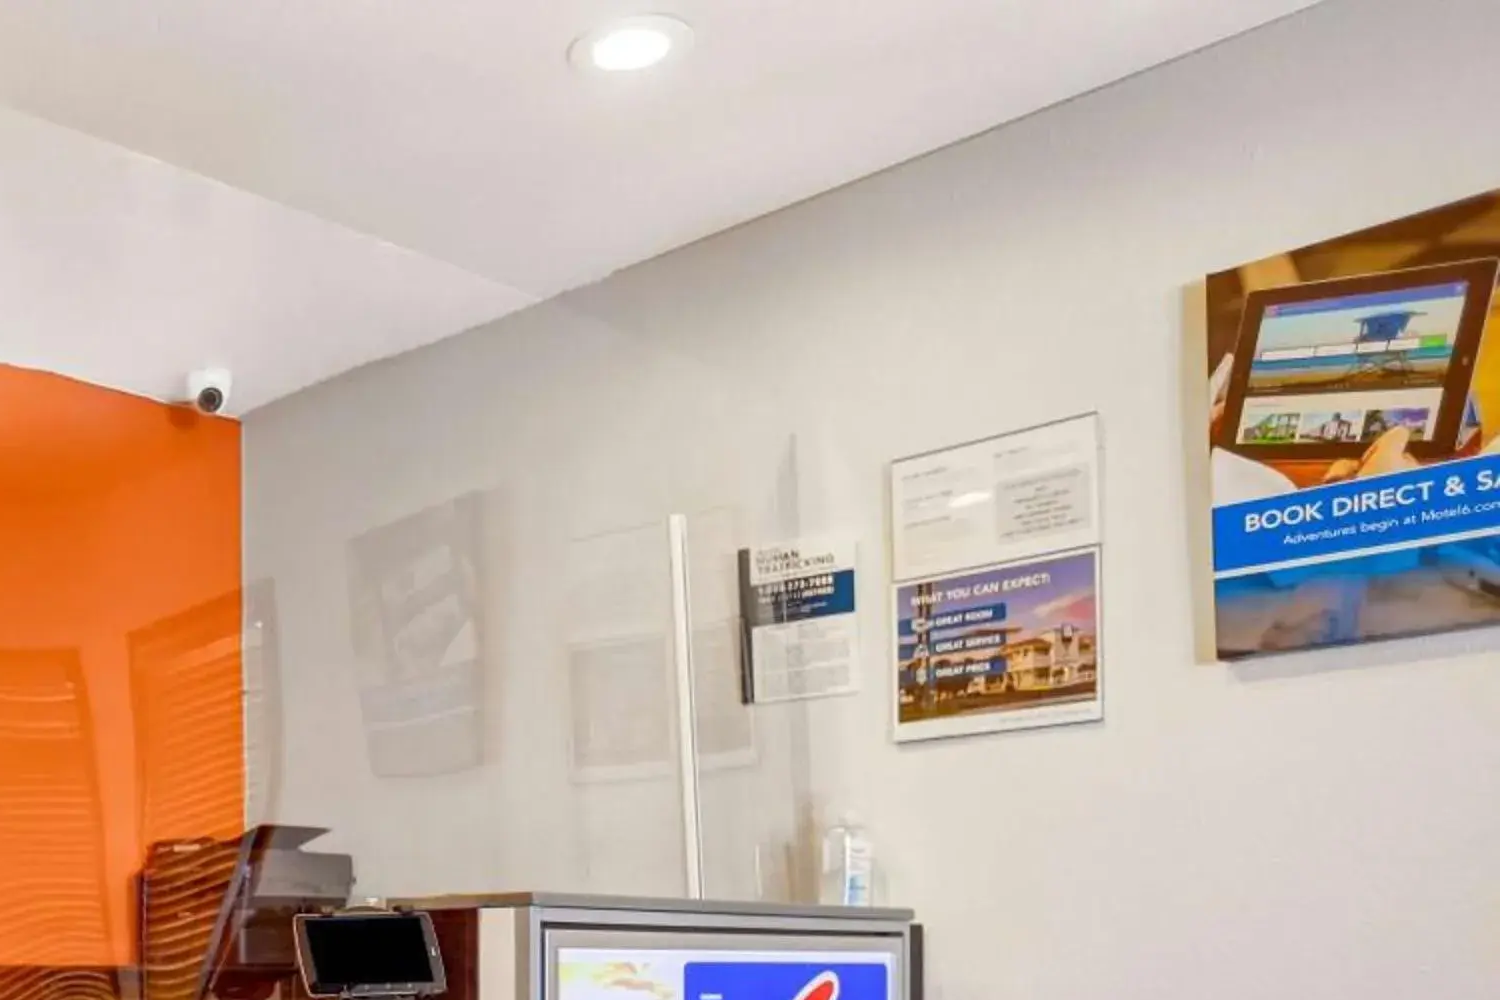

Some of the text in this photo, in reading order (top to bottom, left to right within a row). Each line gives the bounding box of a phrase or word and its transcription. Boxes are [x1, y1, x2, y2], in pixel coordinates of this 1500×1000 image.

[1244, 501, 1324, 533] BOOK
[1332, 480, 1435, 517] DIRECT
[1443, 475, 1467, 497] &
[1283, 525, 1357, 545] Adventures
[1360, 518, 1399, 536] begin
[1402, 514, 1417, 526] at
[910, 591, 943, 607] WHAT
[946, 586, 971, 600] YOU
[973, 581, 999, 596] CAN
[935, 614, 963, 627] GREAT
[935, 639, 963, 653] GREAT
[935, 665, 963, 678] GREAT
